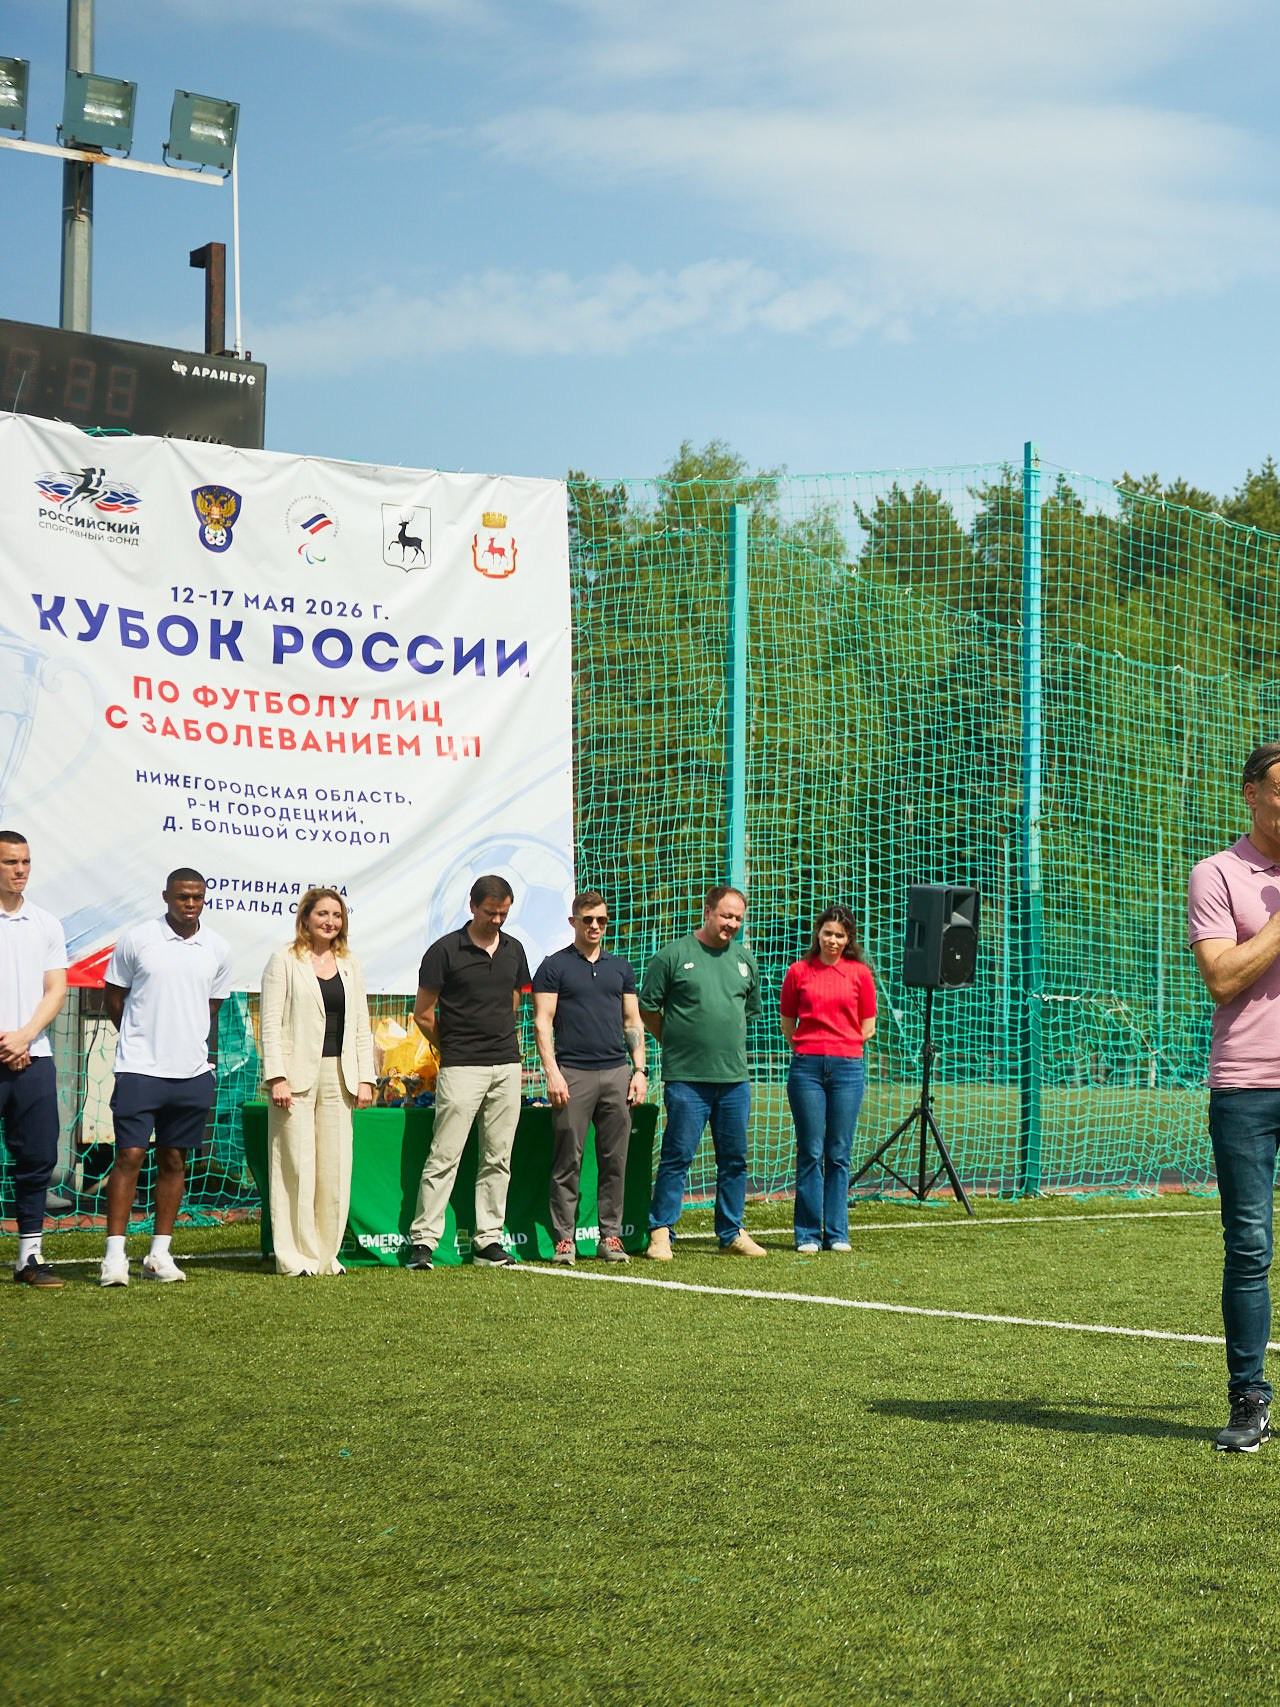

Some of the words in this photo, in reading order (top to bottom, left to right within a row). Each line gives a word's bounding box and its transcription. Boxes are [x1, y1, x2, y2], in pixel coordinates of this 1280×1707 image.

[191, 365, 256, 385] АРАНЕУС
[38, 508, 140, 535] РОССИЙСКИЙ
[38, 521, 105, 541] СПОРТИВНЫЙ
[106, 535, 139, 546] ФОНД
[171, 586, 234, 606] 12-17
[244, 592, 295, 613] МАЯ
[305, 598, 363, 618] 2026
[372, 604, 389, 620] Г.
[31, 593, 246, 662] КУБОК
[272, 624, 531, 678] РОССИИ
[133, 676, 180, 703] ПО
[192, 685, 360, 718] ФУТБОЛУ
[370, 698, 443, 727] ЛИЦ
[105, 704, 128, 729] С
[140, 712, 421, 757] ЗАБОЛЕВАНИЕМ
[435, 735, 481, 761] ЦП
[136, 769, 308, 800] НИЖЕГОРОДСКАЯ
[315, 788, 413, 805] ОБЛАСТЬ,
[187, 797, 220, 813] Р-Н
[227, 802, 364, 824] ГОРОДЕЦКИЙ,
[163, 816, 183, 831] Д.
[191, 818, 288, 840] БОЛЬШОЙ
[295, 828, 390, 845] СУХОДОЛ
[206, 878, 300, 895] ОРТИВНАЯ
[203, 897, 283, 915] МЕРАЛЬД
[380, 1246, 407, 1255] SPORT
